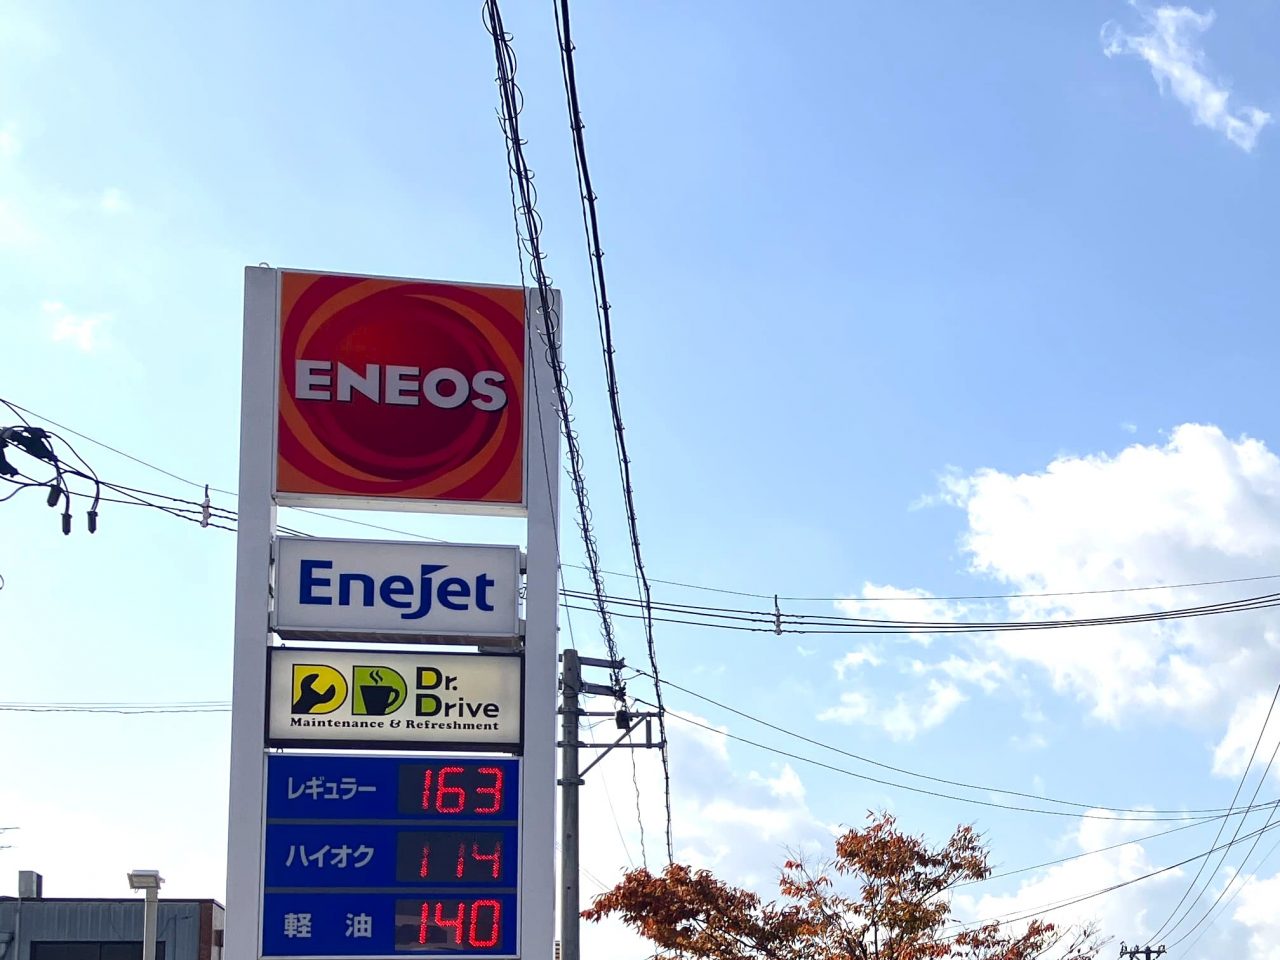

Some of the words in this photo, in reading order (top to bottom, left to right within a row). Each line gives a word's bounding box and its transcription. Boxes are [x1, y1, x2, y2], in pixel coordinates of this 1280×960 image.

[294, 358, 508, 412] ENEOS
[416, 666, 459, 692] Dr.
[415, 693, 500, 719] Drive
[290, 717, 384, 729] Maintenance
[389, 718, 400, 730] &
[405, 719, 499, 731] Refreshment
[287, 776, 377, 801] レギュラー
[421, 766, 503, 814] 163
[286, 844, 375, 869] ハイオク
[418, 899, 501, 948] 140
